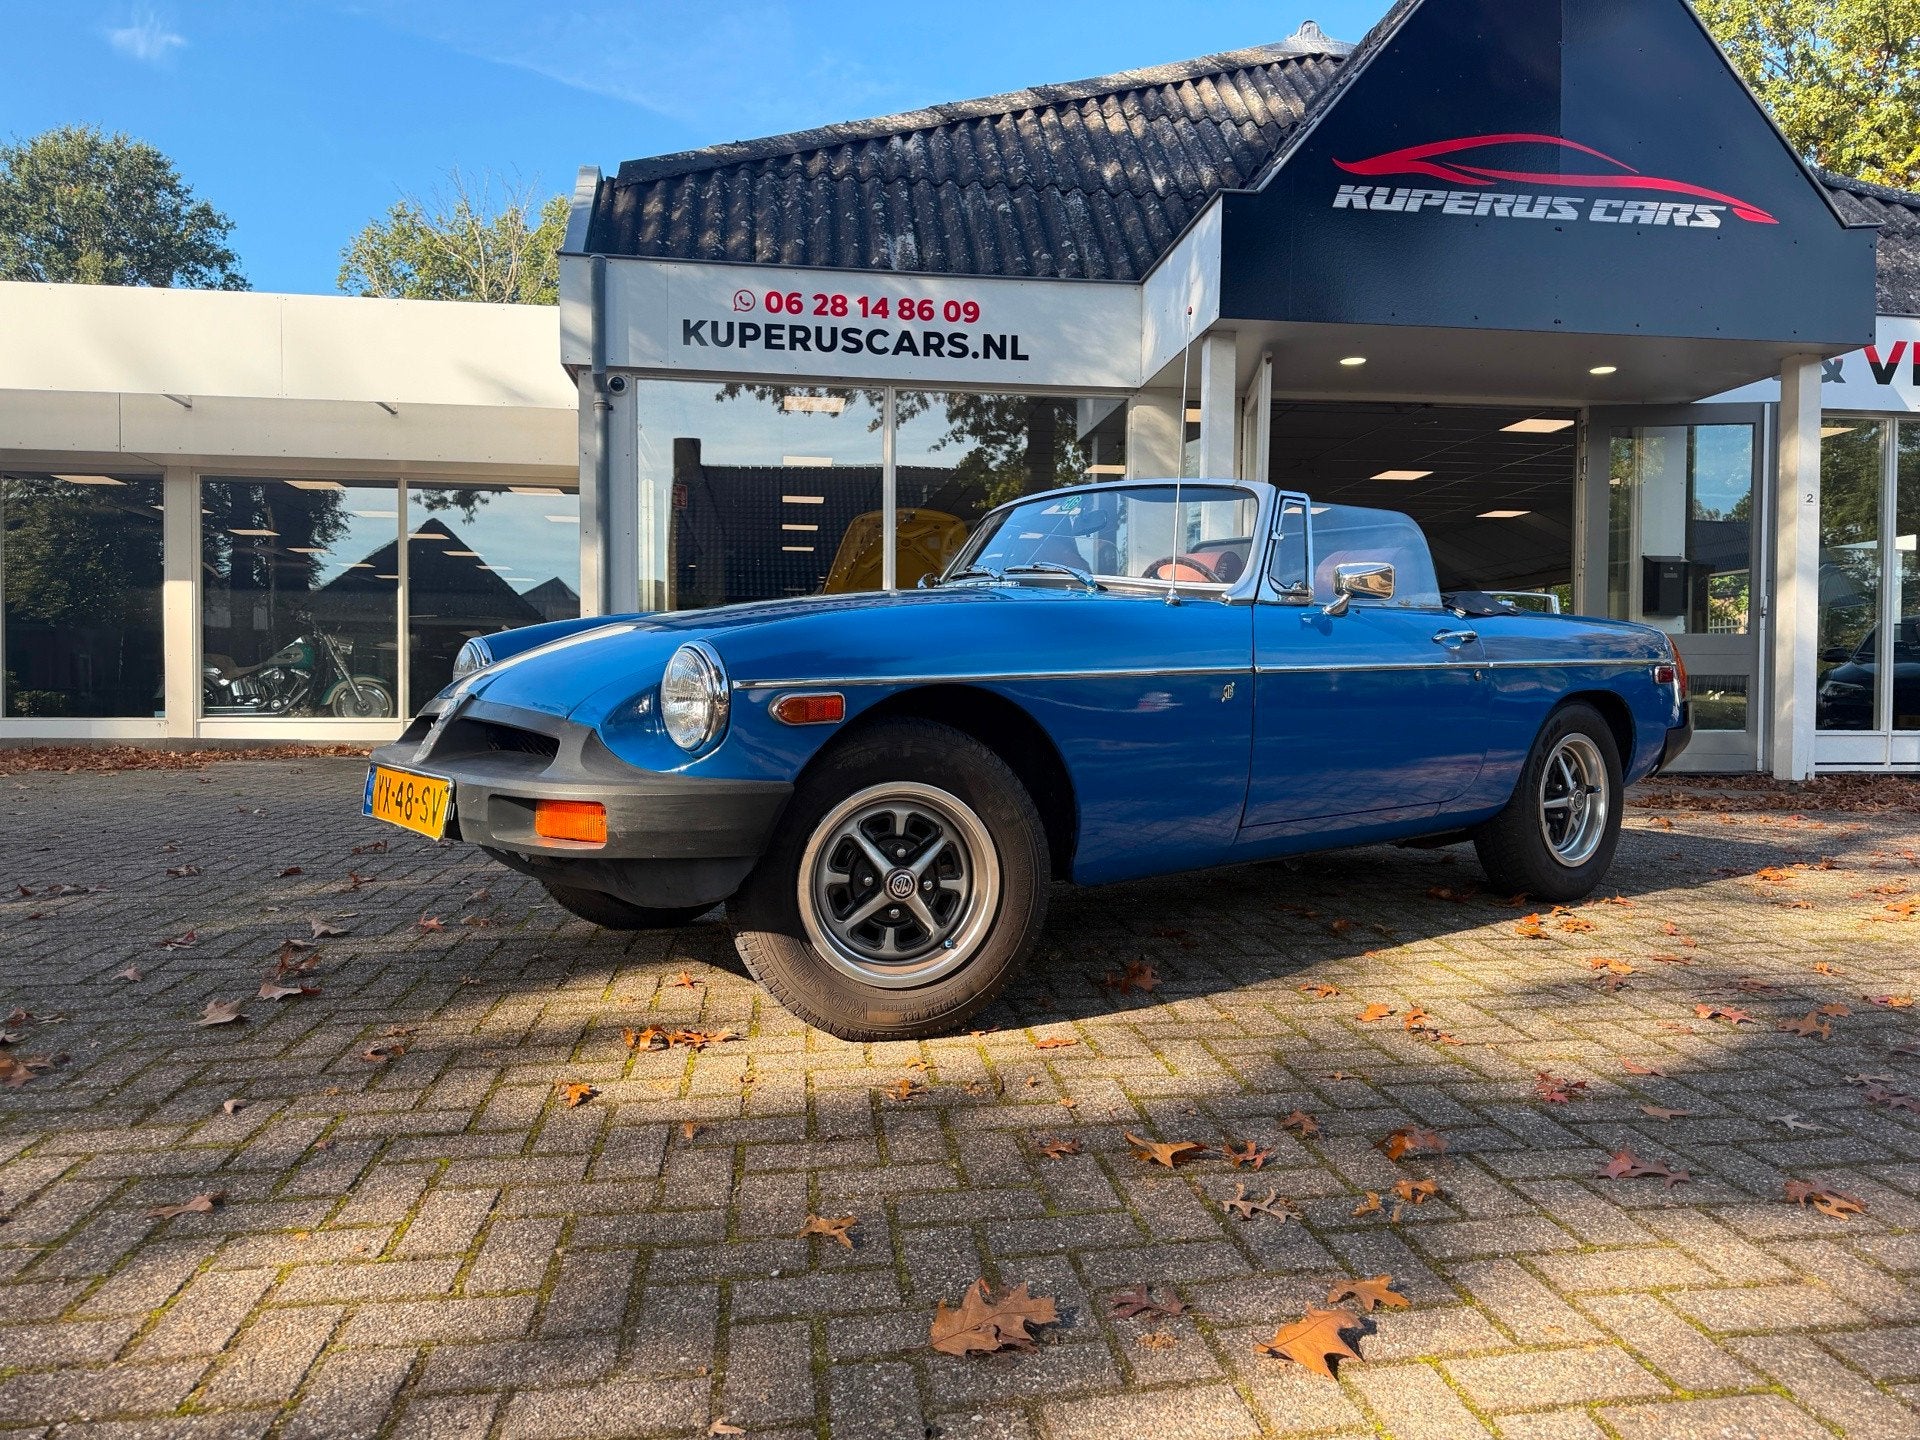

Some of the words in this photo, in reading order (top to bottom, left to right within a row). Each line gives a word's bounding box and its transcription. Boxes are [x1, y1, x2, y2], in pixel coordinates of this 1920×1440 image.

[1332, 185, 1585, 221] KUPERUS
[1588, 199, 1727, 229] CARS
[765, 291, 803, 316] 06
[813, 293, 849, 318] 28
[857, 296, 890, 319] 14
[897, 298, 936, 321] 86
[943, 300, 981, 324] 09
[682, 318, 1030, 362] KUPERUSCARS.NL
[1805, 493, 1814, 503] 2
